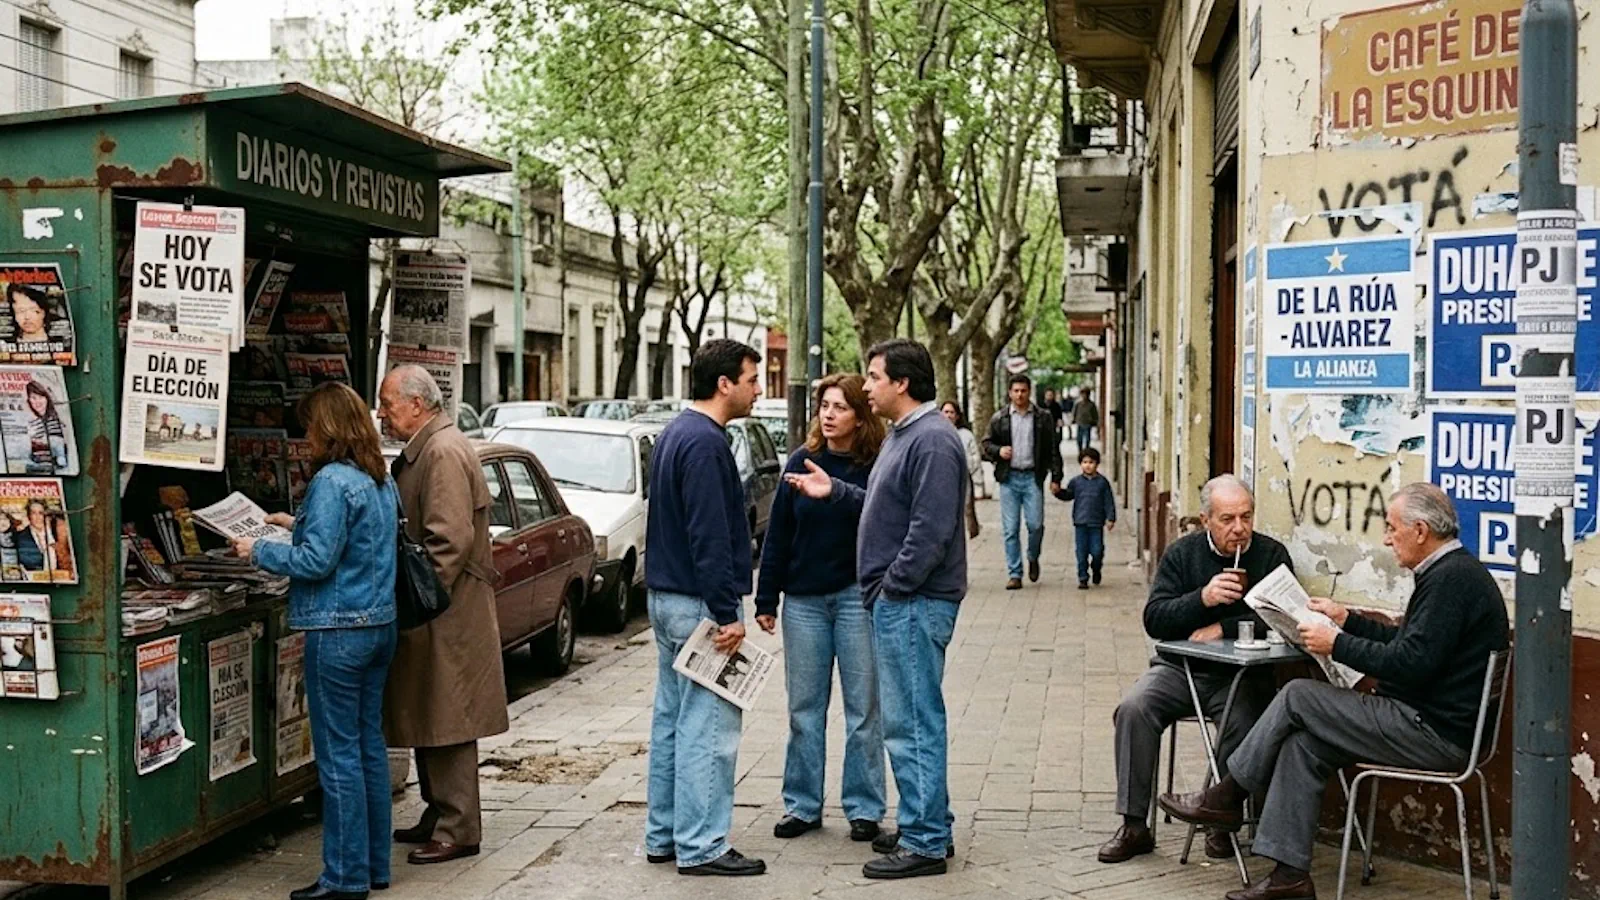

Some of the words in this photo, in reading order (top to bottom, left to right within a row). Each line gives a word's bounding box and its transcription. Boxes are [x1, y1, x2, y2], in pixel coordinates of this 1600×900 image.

[1368, 8, 1461, 74] CAFÉ
[1472, 8, 1521, 60] DE
[1331, 86, 1373, 131] LA
[1384, 65, 1519, 124] ESQUIN
[237, 131, 323, 198] DIARIOS
[328, 156, 341, 202] Y
[346, 162, 425, 222] REVISTAS
[1319, 146, 1468, 238] VOTÁ
[165, 233, 212, 261] HOY
[1521, 246, 1558, 284] PJ
[139, 261, 168, 289] SE
[175, 264, 233, 294] VOTA
[1439, 238, 1597, 295] DUHE
[1277, 287, 1304, 315] DE
[1313, 285, 1341, 314] LA
[1350, 276, 1398, 313] RÚA
[1442, 294, 1592, 325] PRESIE
[1281, 318, 1391, 349] -ALVAREZ
[148, 351, 178, 374] DÍA
[185, 357, 207, 376] DE
[1294, 360, 1312, 378] LA
[132, 375, 219, 399] ELECCIÓN
[1526, 408, 1564, 445] PJ
[1437, 420, 1595, 476] DUHE
[1283, 460, 1392, 533] VOTÁ
[1440, 473, 1589, 508] PRESIE
